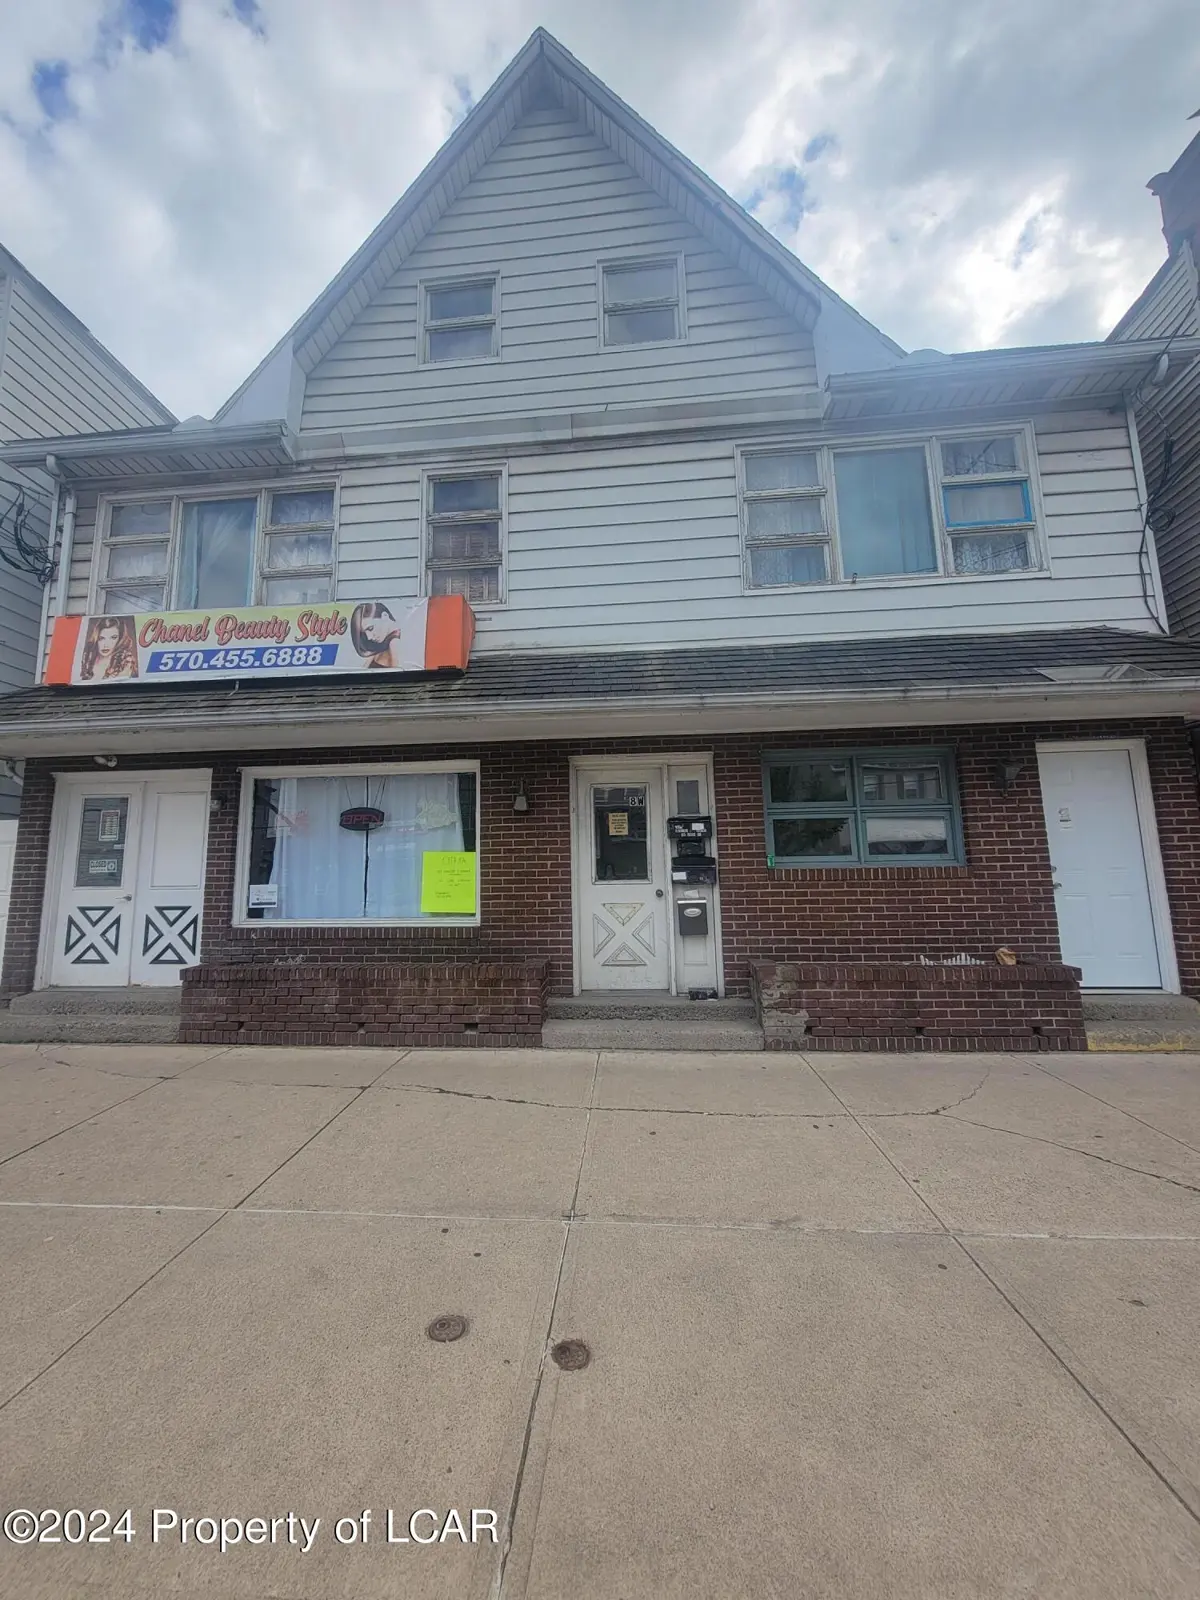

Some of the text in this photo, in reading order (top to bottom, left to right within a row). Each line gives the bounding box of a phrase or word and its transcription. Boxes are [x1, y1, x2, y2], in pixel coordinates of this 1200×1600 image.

[138, 609, 348, 648] Chanel Beauty Style
[158, 646, 323, 671] 570.455.6888
[342, 813, 382, 825] OPEN
